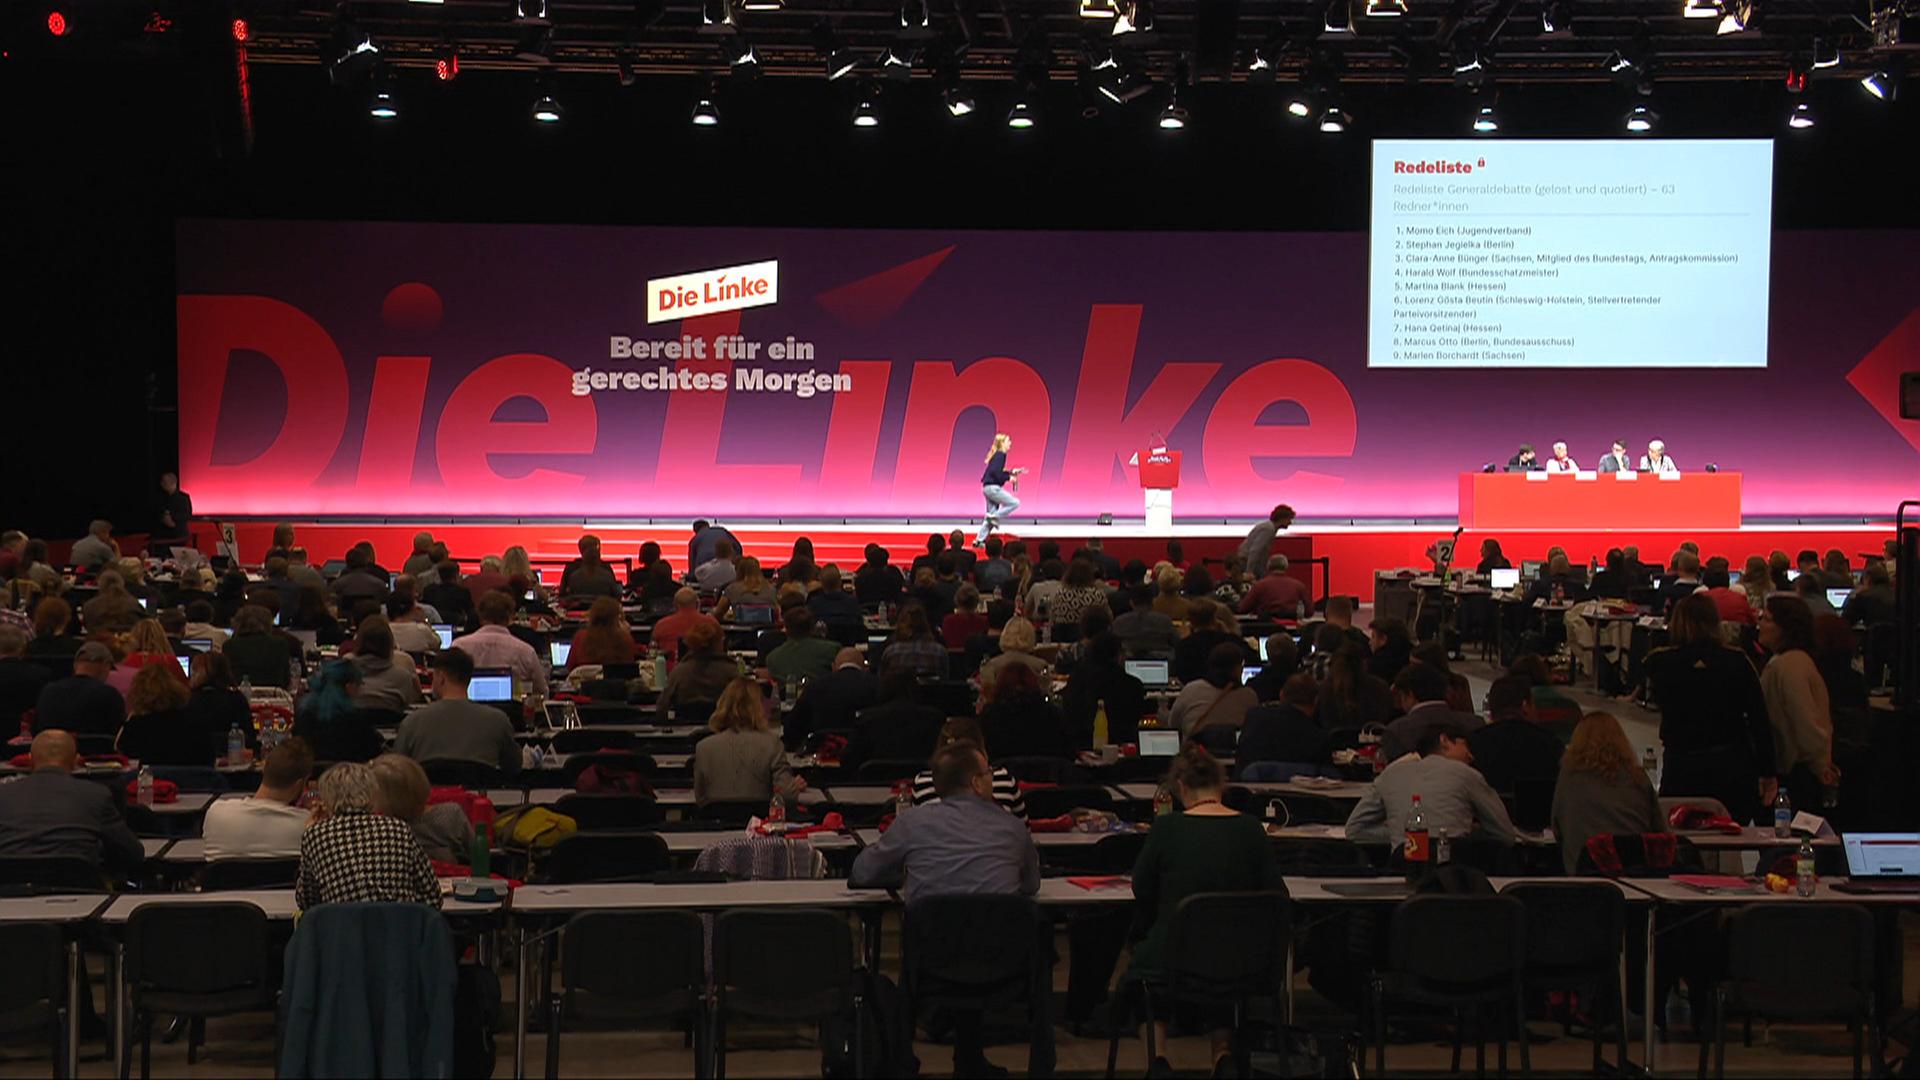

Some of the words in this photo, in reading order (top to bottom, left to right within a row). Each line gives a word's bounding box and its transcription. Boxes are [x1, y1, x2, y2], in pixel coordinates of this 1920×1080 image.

[1394, 160, 1473, 174] Redeliste
[1393, 183, 1444, 195] Redeliste
[1447, 183, 1532, 195] Generaldebatte
[1535, 183, 1572, 197] (gelost
[1575, 184, 1597, 195] und
[1600, 183, 1648, 197] quotiert)
[1661, 184, 1676, 195] 63
[1396, 226, 1404, 235] 1.
[1406, 226, 1434, 236] Momo
[1436, 226, 1455, 235] Eich
[1457, 226, 1532, 237] (Jugendverband)
[1395, 240, 1403, 249] 2.
[1406, 240, 1442, 251] Stephan
[1483, 240, 1515, 250] (Berlin)
[1395, 254, 1403, 263] 3.
[1406, 253, 1455, 263] Clara-Anne
[1458, 253, 1489, 265] Bünger
[1491, 254, 1534, 264] (Sachsen,
[1537, 254, 1572, 265] Mitglied
[1574, 254, 1590, 263] des
[1593, 253, 1647, 264] Bundestags,
[1649, 253, 1739, 265] Antragskommission)
[1395, 268, 1403, 277] 4.
[1405, 268, 1435, 277] Harald
[1437, 268, 1456, 277] Wolf
[1458, 267, 1559, 278] (Bundesschatzmeister)
[1394, 281, 1402, 291] 5.
[1405, 281, 1439, 291] Martina
[1441, 281, 1465, 291] Blank
[1467, 281, 1507, 292] (Hessen)
[659, 286, 698, 312] Die
[703, 275, 769, 304] Linke
[1394, 296, 1402, 305] 6.
[1404, 296, 1434, 304] Lorenz
[1437, 295, 1463, 304] Gösta
[1465, 296, 1493, 304] Beutin
[1495, 295, 1586, 306] (Schleswig-Holstein,
[1588, 296, 1662, 304] Stellvertretender
[1393, 309, 1477, 319] Parteivorsitzender)
[1394, 324, 1402, 333] 7.
[1404, 324, 1427, 333] Hana
[1463, 323, 1502, 333] (Hessen)
[610, 335, 707, 360] Bereit
[713, 335, 761, 360] für
[768, 336, 814, 360] ein
[1393, 338, 1402, 346] 8.
[1404, 338, 1437, 346] Marcus
[1438, 337, 1458, 346] Otto
[1460, 337, 1491, 347] (Berlin,
[1493, 337, 1575, 347] Bundesausschuss)
[1392, 351, 1401, 360] 9.
[1436, 351, 1479, 360] Borchardt
[1481, 351, 1526, 361] (Sachsen)
[177, 283, 598, 508] Die
[650, 246, 1358, 508] Linke
[571, 366, 728, 396] gerechtes
[735, 368, 852, 397] Morgen
[225, 529, 233, 544] 3
[1440, 546, 1451, 562] 2
